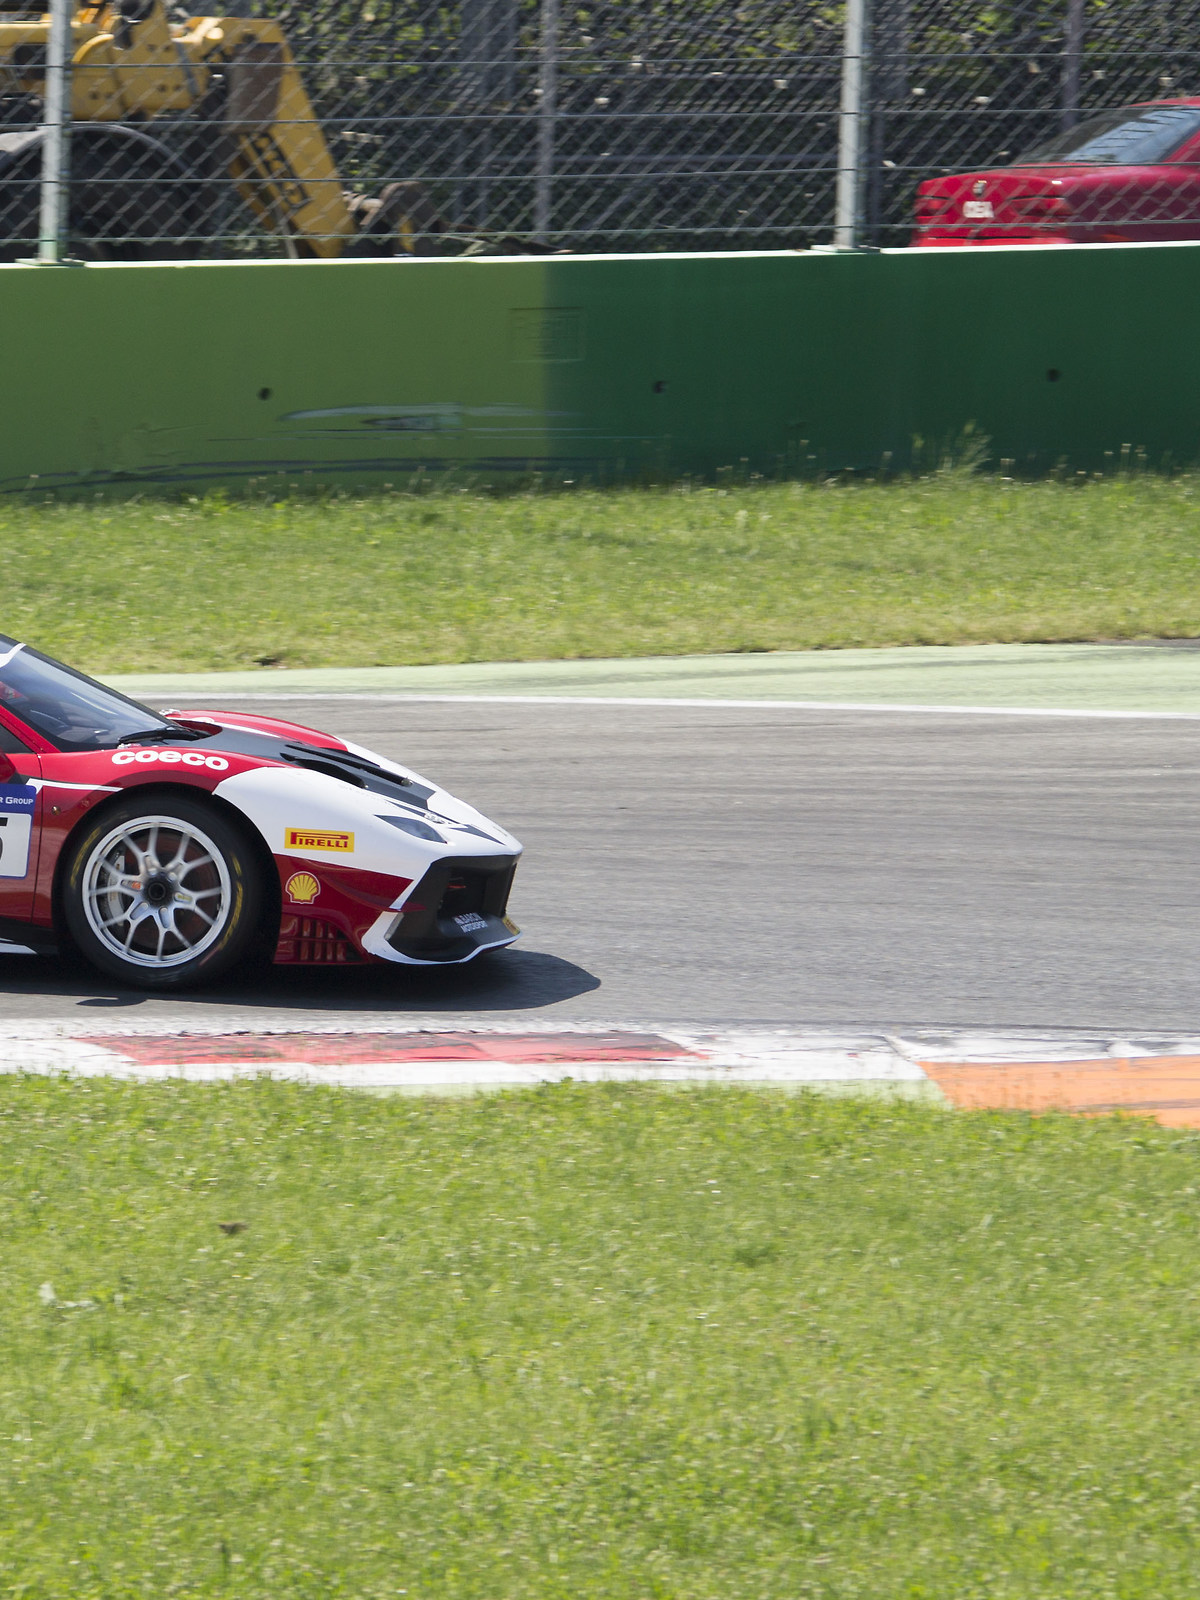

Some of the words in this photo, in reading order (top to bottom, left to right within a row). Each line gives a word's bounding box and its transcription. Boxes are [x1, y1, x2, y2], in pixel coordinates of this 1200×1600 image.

[112, 750, 229, 771] coeco
[5, 796, 34, 805] GROUP
[290, 832, 349, 849] PIRELLI
